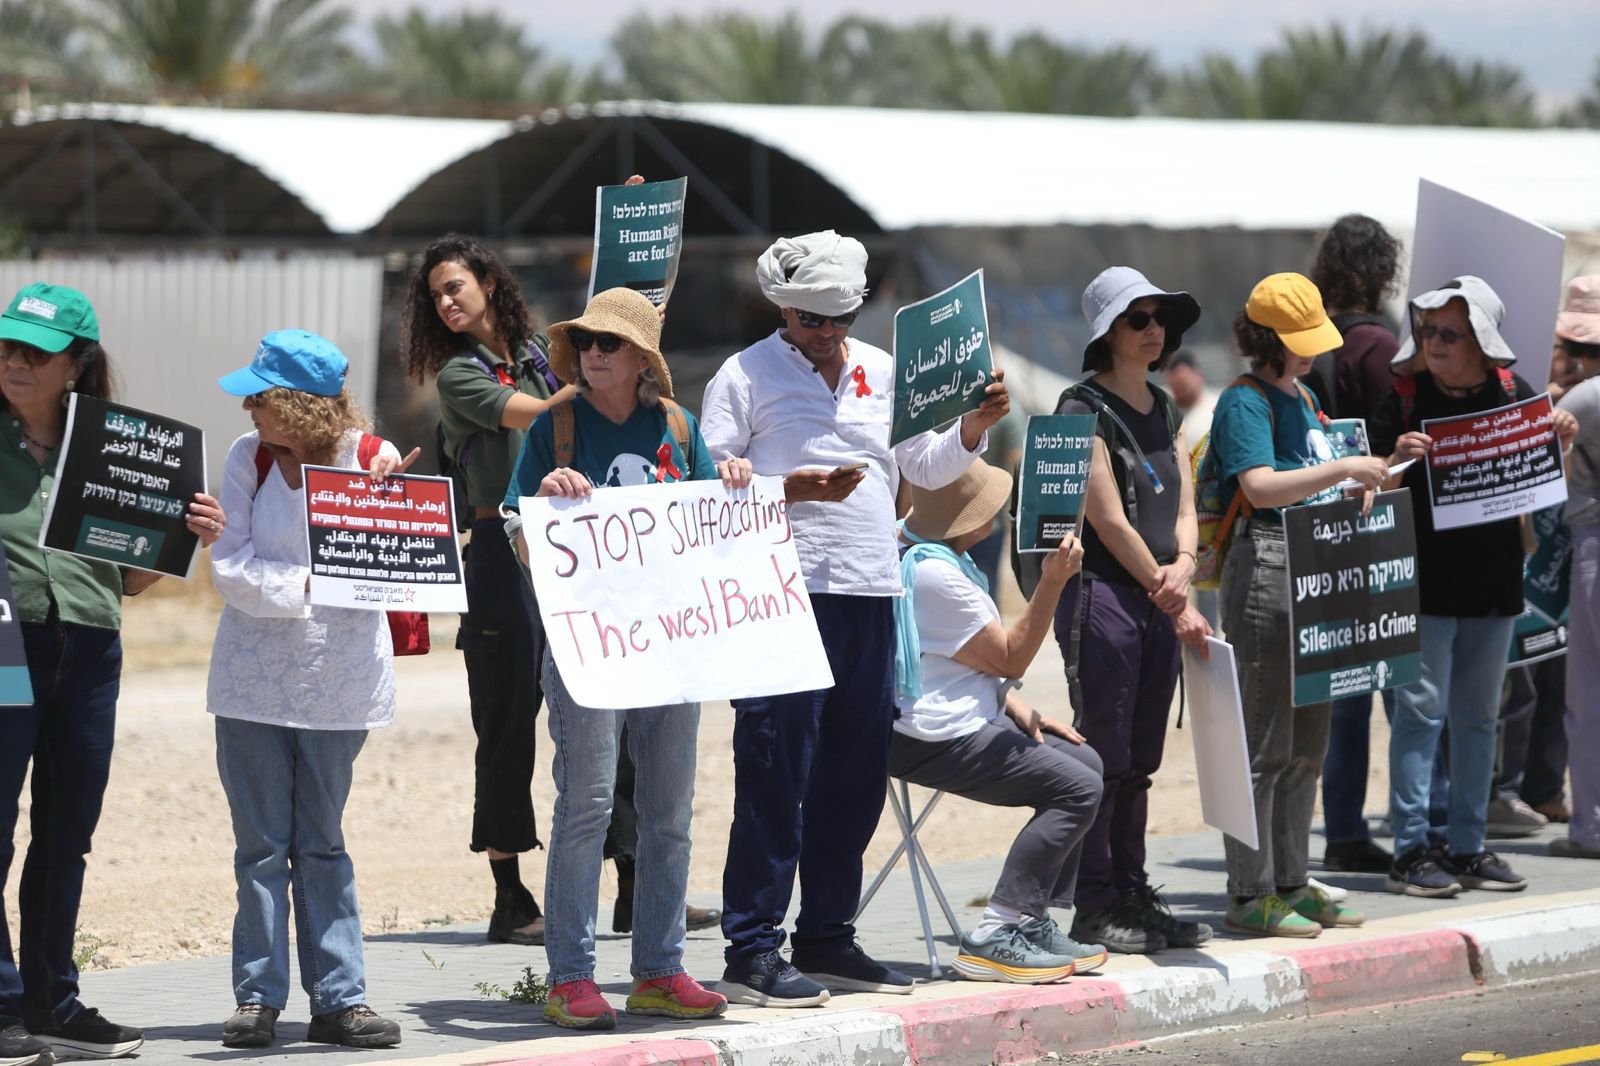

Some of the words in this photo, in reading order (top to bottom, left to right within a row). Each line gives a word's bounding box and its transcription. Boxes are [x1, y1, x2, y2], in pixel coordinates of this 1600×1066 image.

[613, 202, 647, 219] לכולם!
[648, 204, 658, 216] זה
[619, 229, 662, 244] Human
[628, 250, 648, 262] are
[651, 245, 665, 260] for
[955, 326, 984, 364] حقوق
[906, 336, 951, 384] الانسان
[962, 369, 986, 401] هي
[908, 369, 962, 419] للجميع!
[105, 414, 137, 438] يتوقف
[138, 421, 146, 437] لا
[101, 440, 138, 456] الاخضر
[1034, 433, 1063, 448] לכולם!
[1064, 436, 1074, 448] זה
[139, 442, 163, 462] الخط
[164, 454, 181, 468] عند
[1036, 460, 1076, 474] Human
[82, 482, 116, 500] הירוק
[348, 478, 366, 488] ضد
[370, 480, 404, 493] تضامن
[1040, 482, 1060, 494] are
[1062, 478, 1078, 494] for
[118, 490, 137, 506] בקו
[140, 494, 166, 514] עוצר
[354, 494, 413, 509] المستوطنين
[166, 500, 183, 516] לא
[416, 500, 446, 516] إرهاب
[1356, 504, 1395, 532] الصمت
[1313, 517, 1352, 544] جريمة
[371, 533, 398, 550] لإنهاء
[402, 537, 435, 550] نناضل
[545, 507, 656, 578] STOP
[319, 544, 374, 562] والرأسمالية
[378, 550, 410, 566] الأبدية
[415, 554, 446, 566] الحرب
[1337, 566, 1364, 594] היא
[1368, 556, 1415, 592] שתיקה
[1296, 571, 1333, 602] פשע
[551, 610, 650, 666] The
[720, 553, 806, 628] Bank
[1300, 623, 1351, 654] Silence
[1355, 618, 1367, 644] is
[1368, 622, 1377, 641] a
[1379, 610, 1416, 639] Crime
[992, 946, 1026, 962] HOKA
